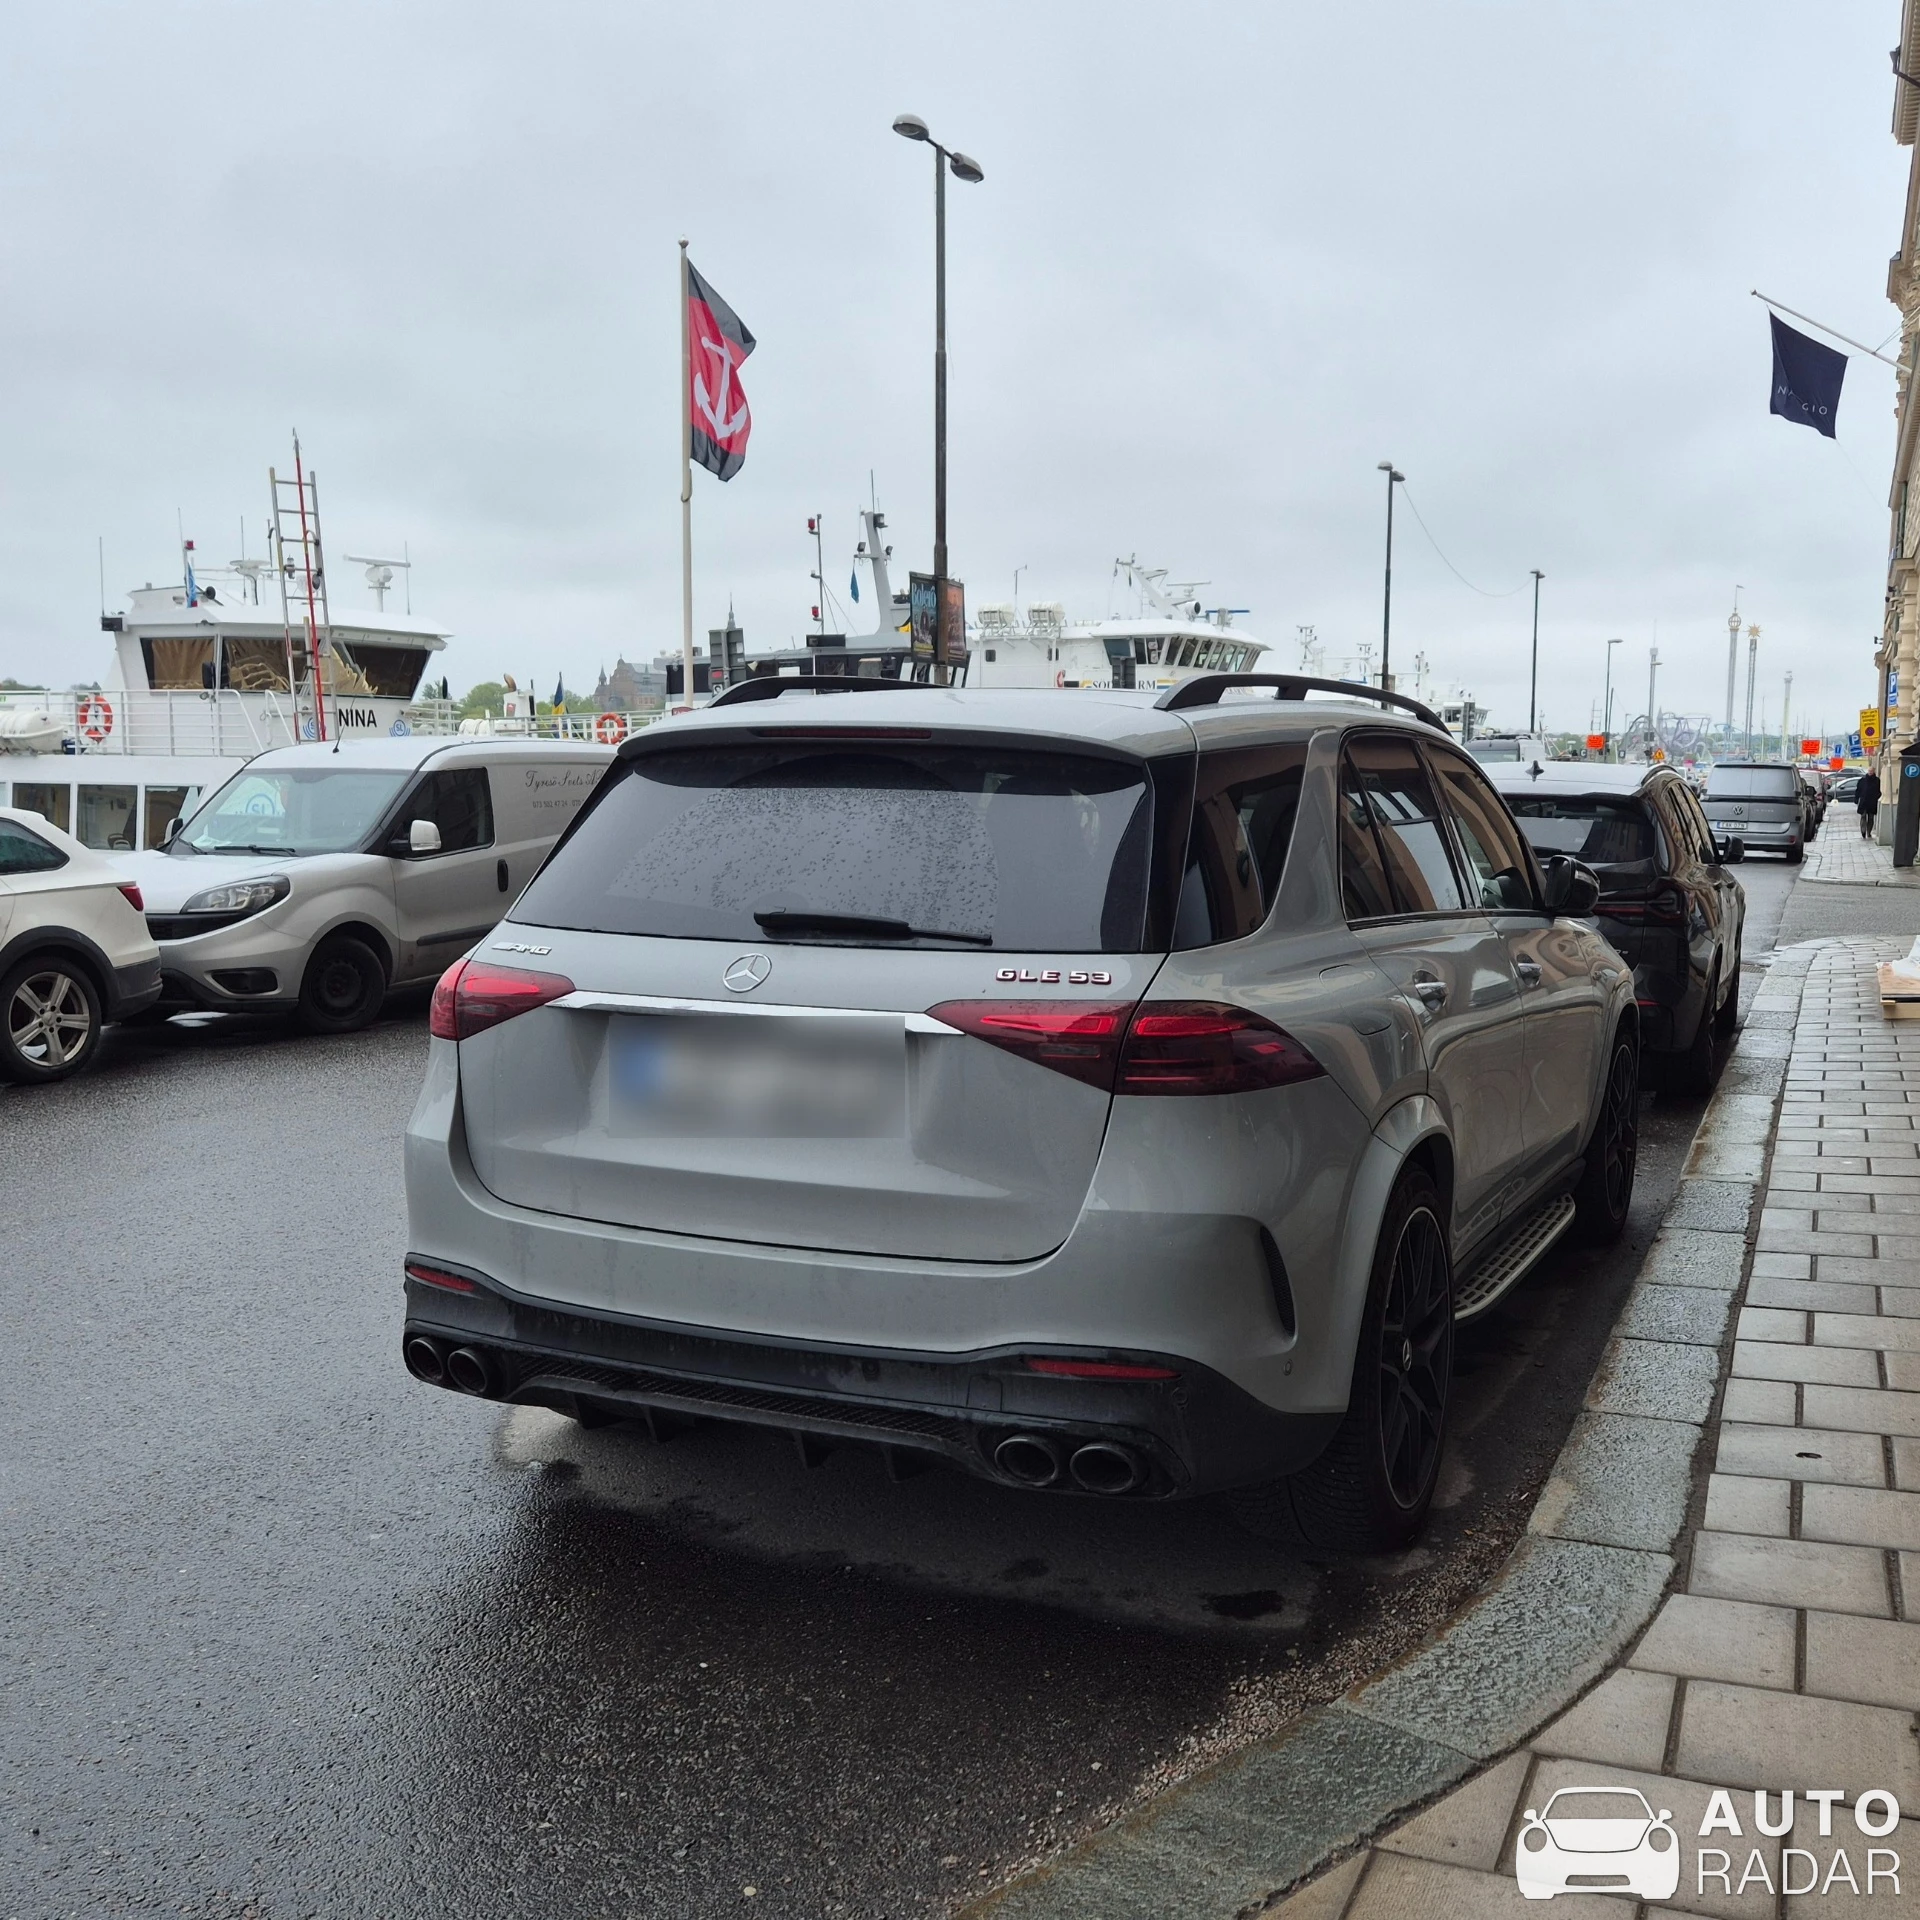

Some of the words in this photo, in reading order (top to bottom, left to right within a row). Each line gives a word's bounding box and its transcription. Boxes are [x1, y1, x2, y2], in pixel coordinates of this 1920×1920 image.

[338, 708, 377, 728] NINA
[508, 943, 552, 955] AMG
[996, 968, 1061, 982] GLE
[1068, 970, 1112, 985] 53
